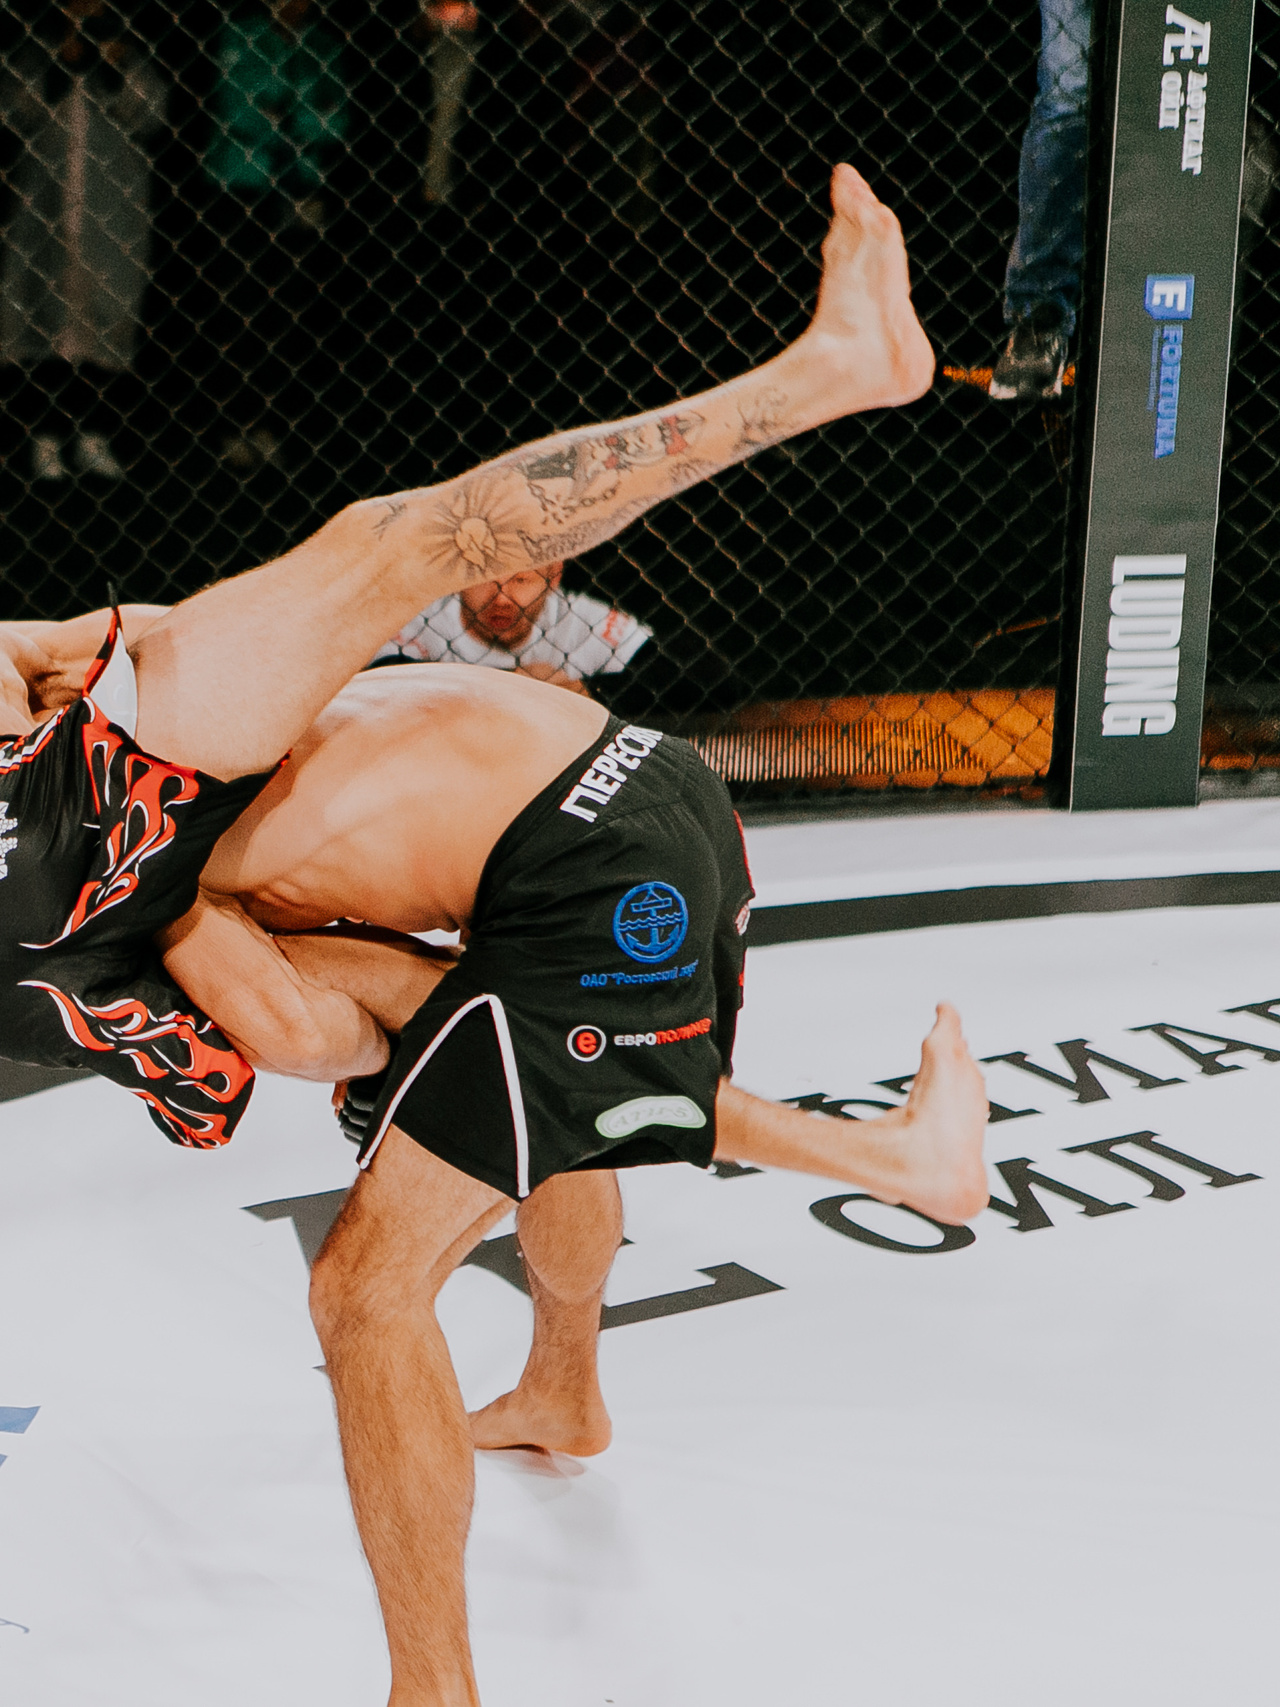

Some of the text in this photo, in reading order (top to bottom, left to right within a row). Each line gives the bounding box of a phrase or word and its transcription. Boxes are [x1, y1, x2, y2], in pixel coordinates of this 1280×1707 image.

[1153, 325, 1183, 459] FORTUNA
[1101, 553, 1187, 737] LUDING
[580, 973, 607, 987] ОАО
